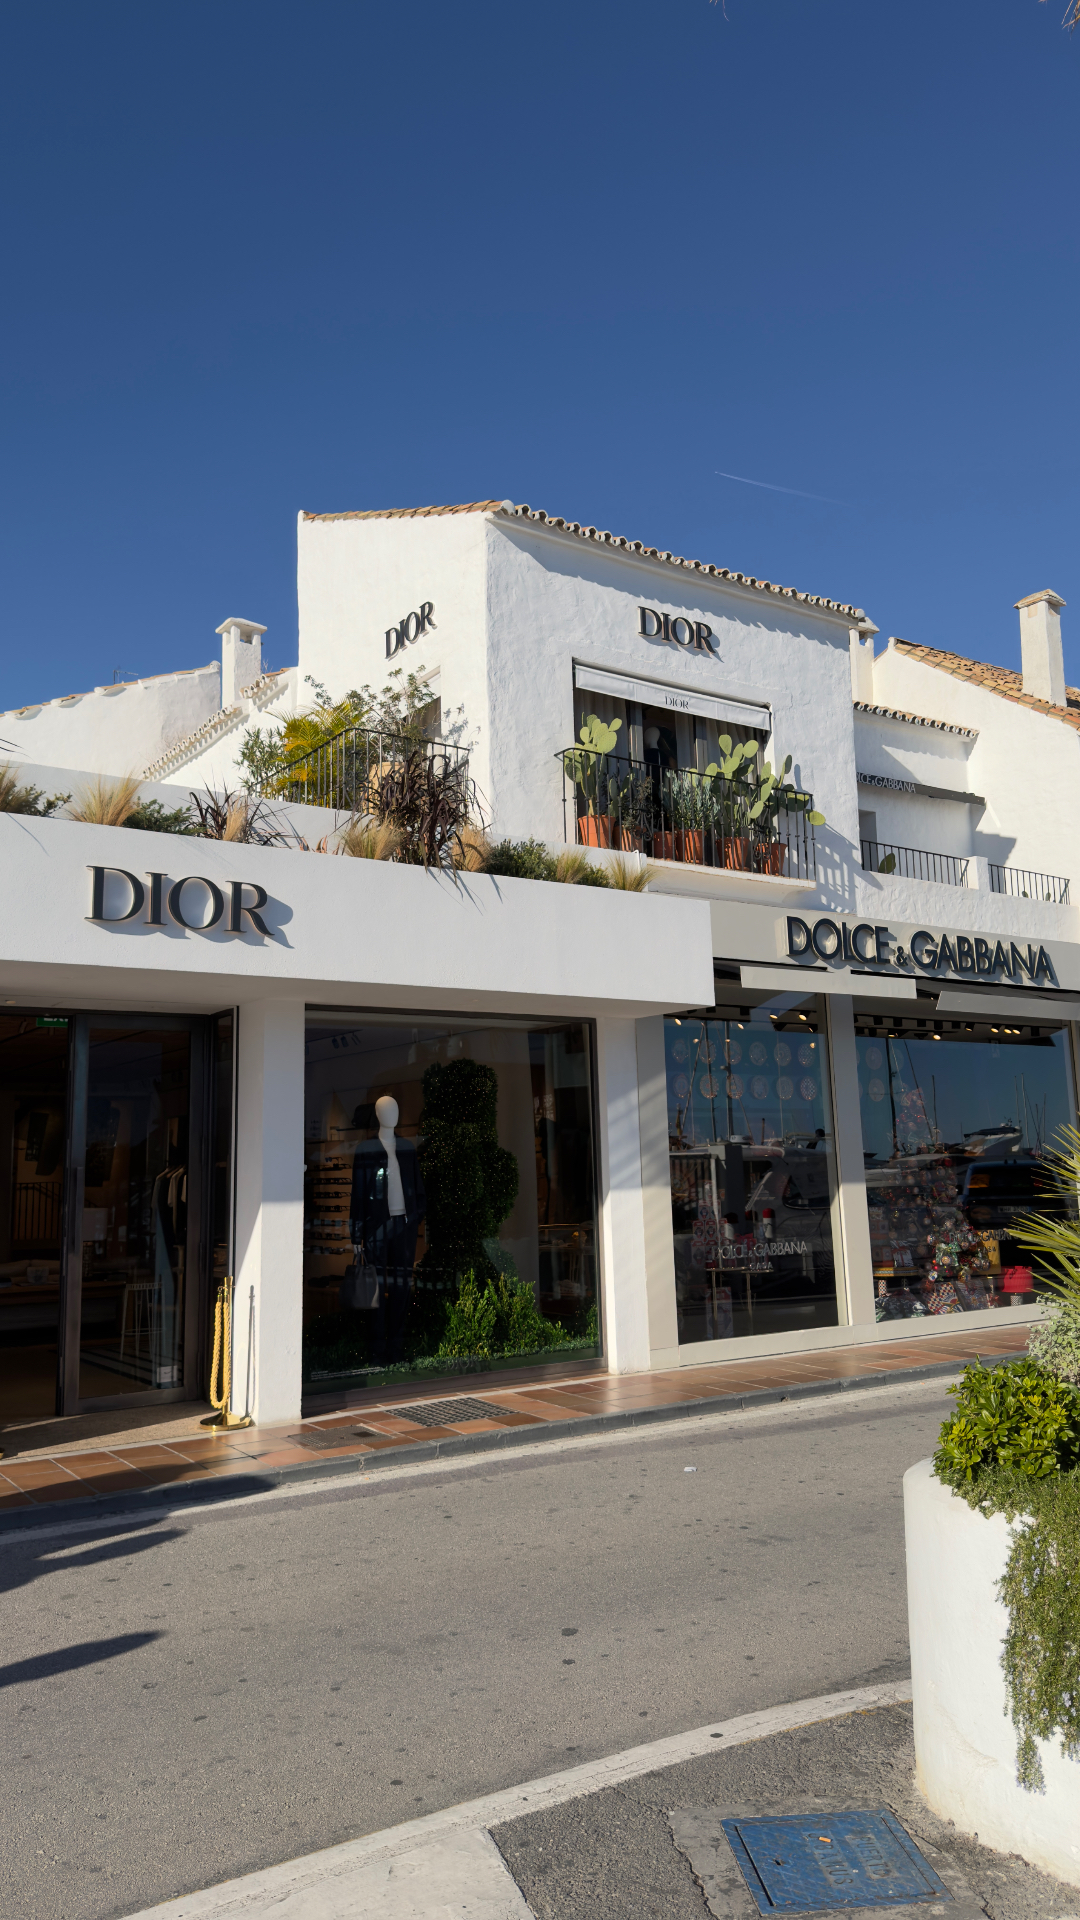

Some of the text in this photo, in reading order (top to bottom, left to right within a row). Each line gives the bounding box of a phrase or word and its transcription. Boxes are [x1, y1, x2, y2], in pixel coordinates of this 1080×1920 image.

[384, 601, 436, 658] DIOR
[638, 606, 716, 654] DIOR
[665, 696, 689, 710] DIOR
[84, 865, 275, 936] DIOR
[851, 1836, 893, 1877] PUERTO
